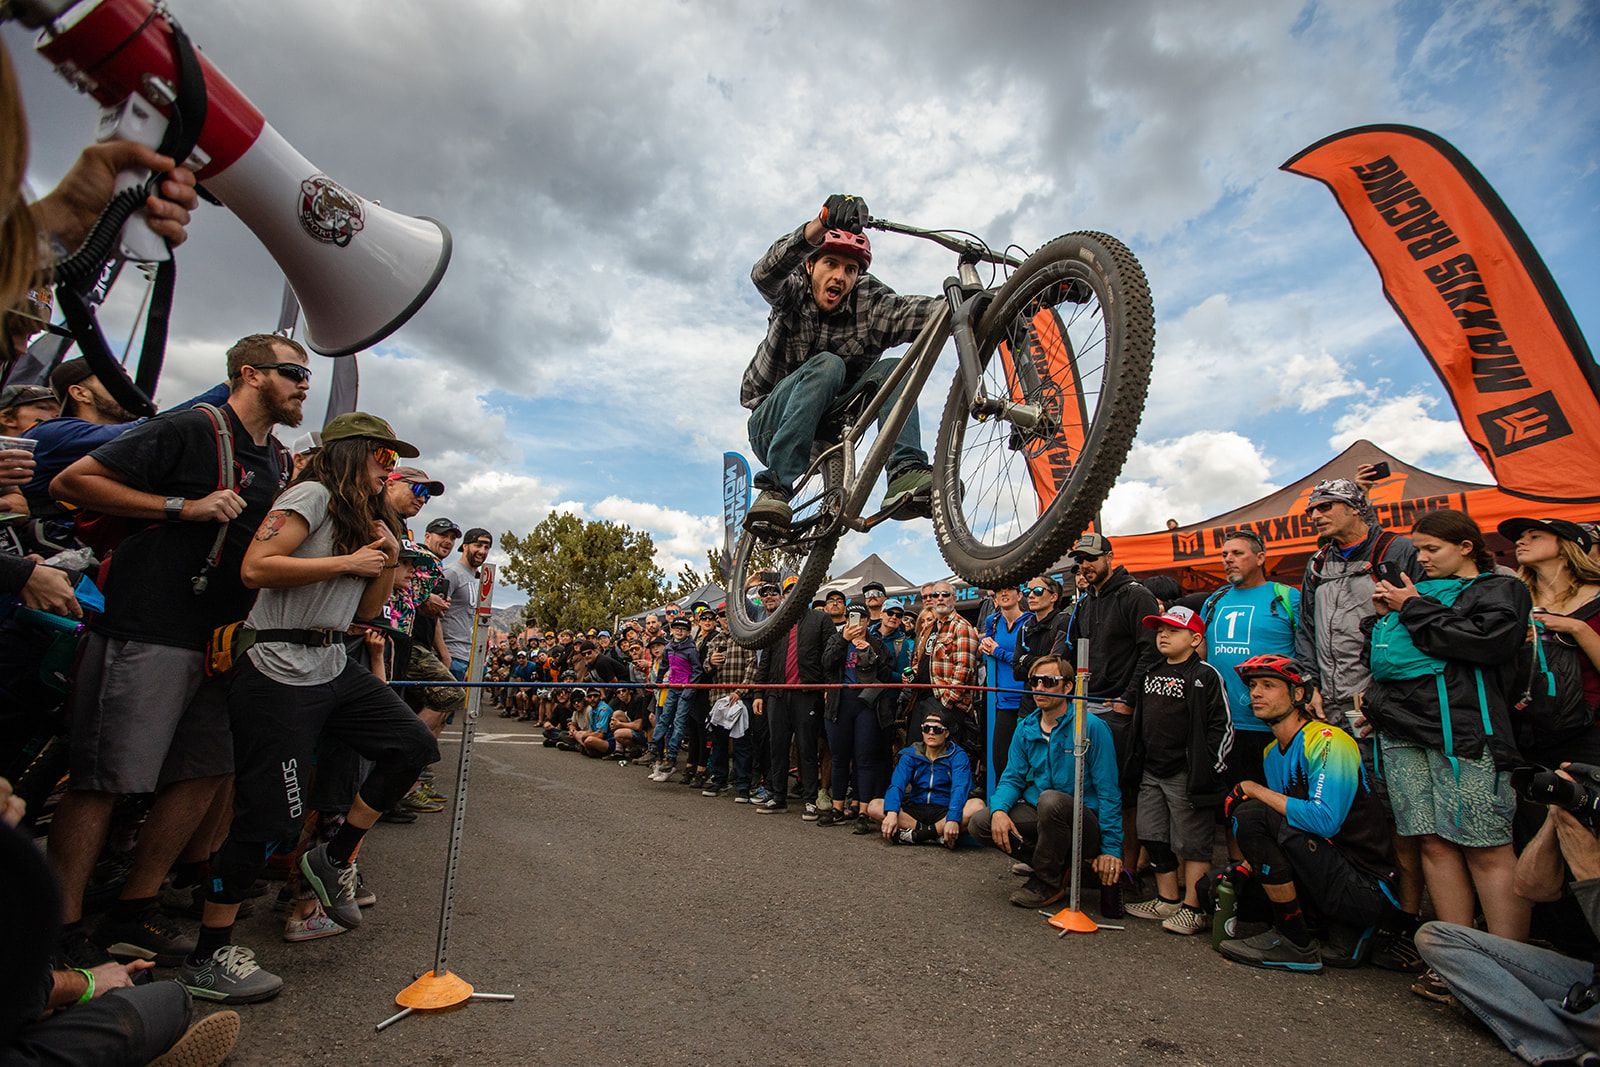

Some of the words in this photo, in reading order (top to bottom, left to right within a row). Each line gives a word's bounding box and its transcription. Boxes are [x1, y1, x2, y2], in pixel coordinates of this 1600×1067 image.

[1350, 155, 1460, 261] RACING
[1423, 253, 1532, 393] MAXXIS
[934, 489, 951, 545] MAXXIS
[1374, 495, 1450, 528] CING
[1225, 611, 1245, 639] 1st
[1215, 644, 1250, 656] phorm
